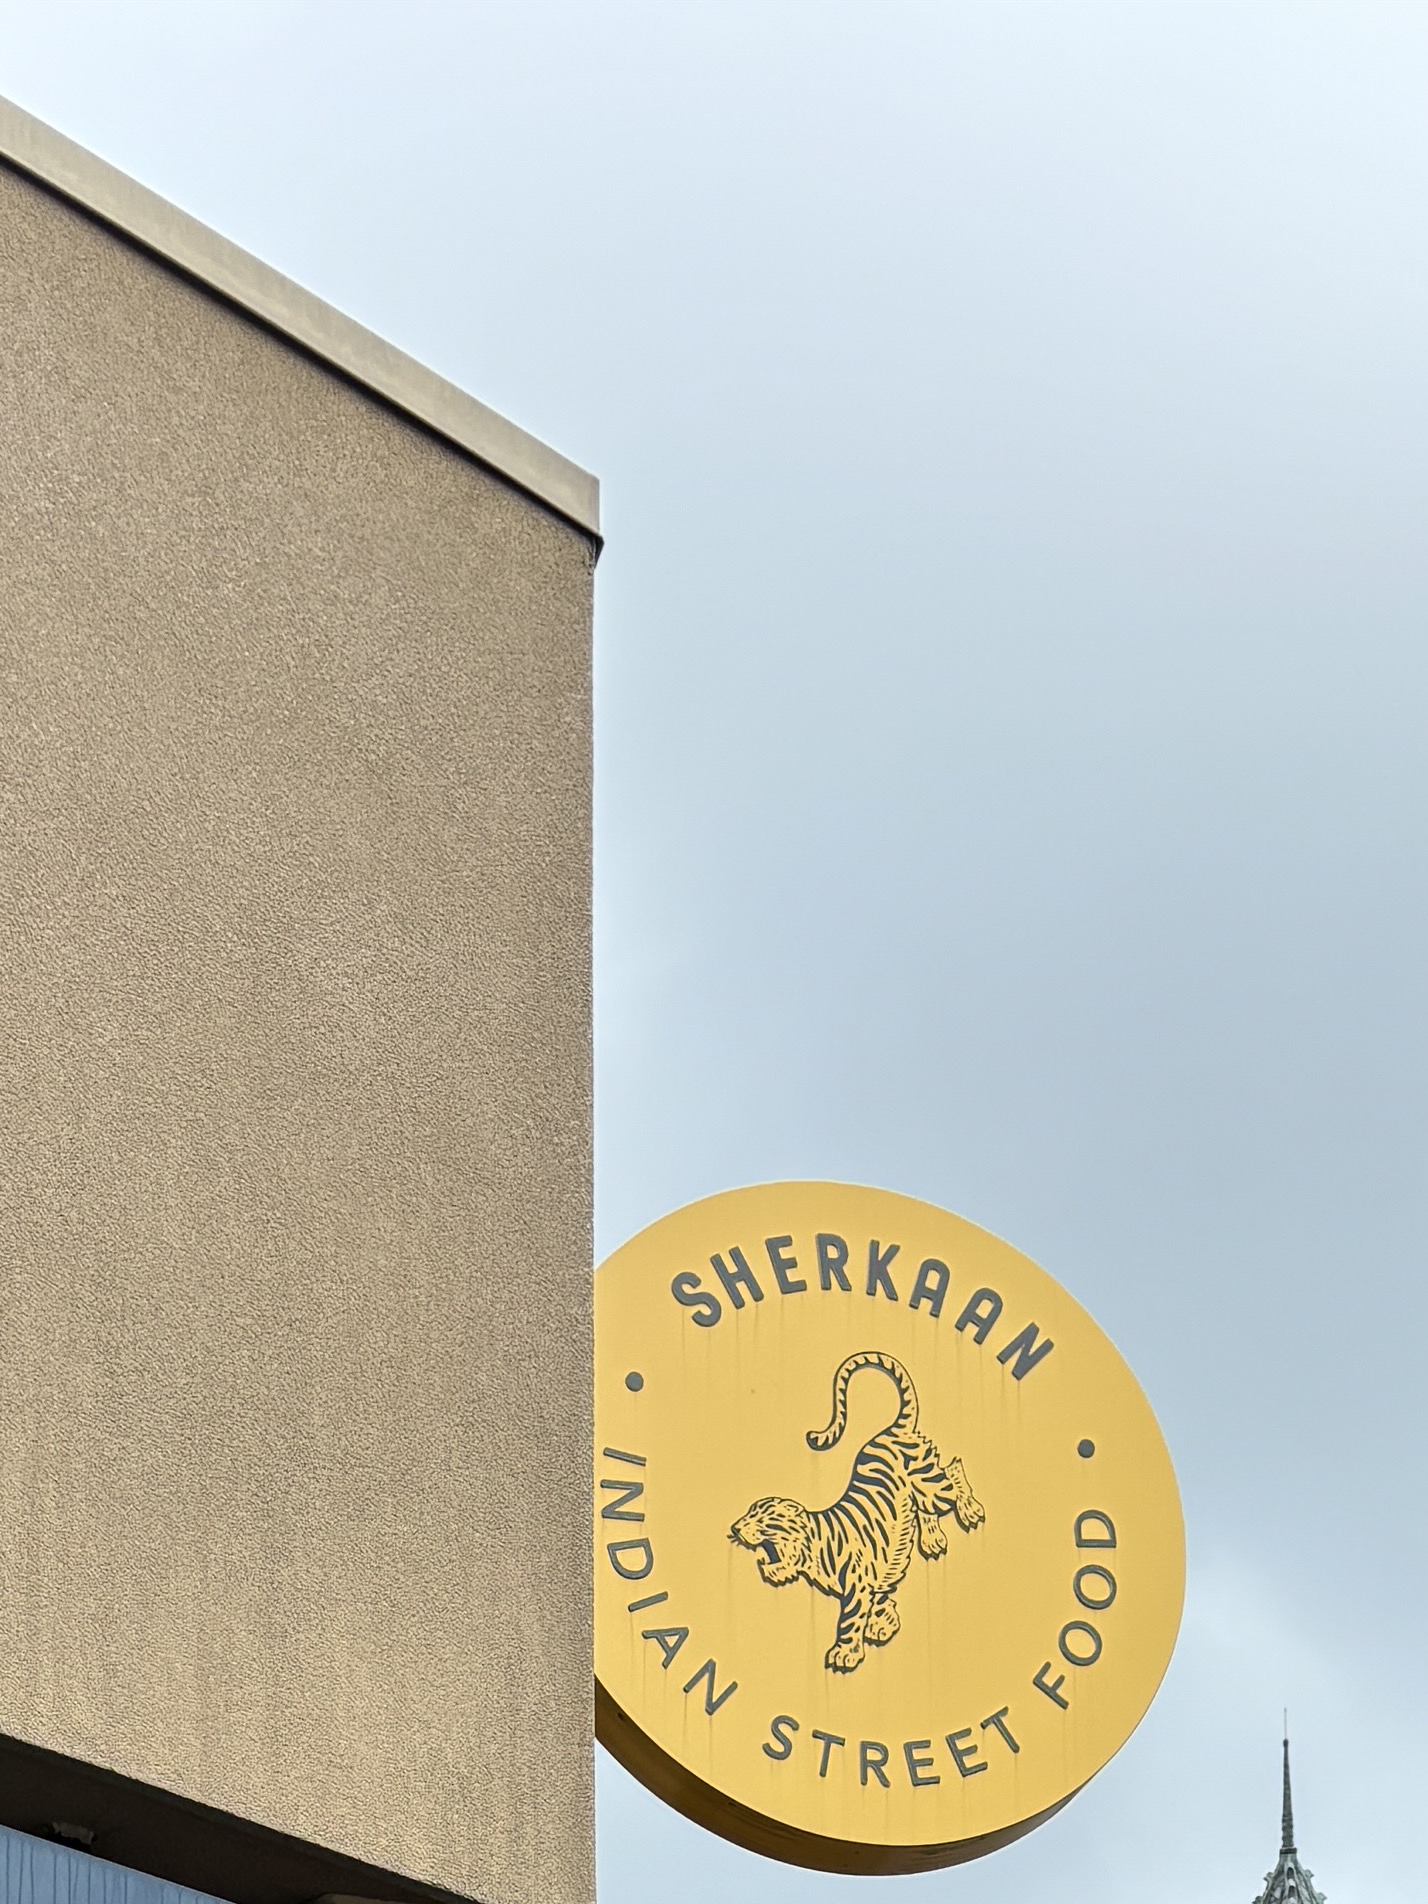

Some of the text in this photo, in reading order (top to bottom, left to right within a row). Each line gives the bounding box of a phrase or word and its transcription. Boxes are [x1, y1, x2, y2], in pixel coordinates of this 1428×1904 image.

[670, 1233, 1054, 1380] SHERKAAN
[600, 1446, 1117, 1789] INDIAN STREET FOOD
